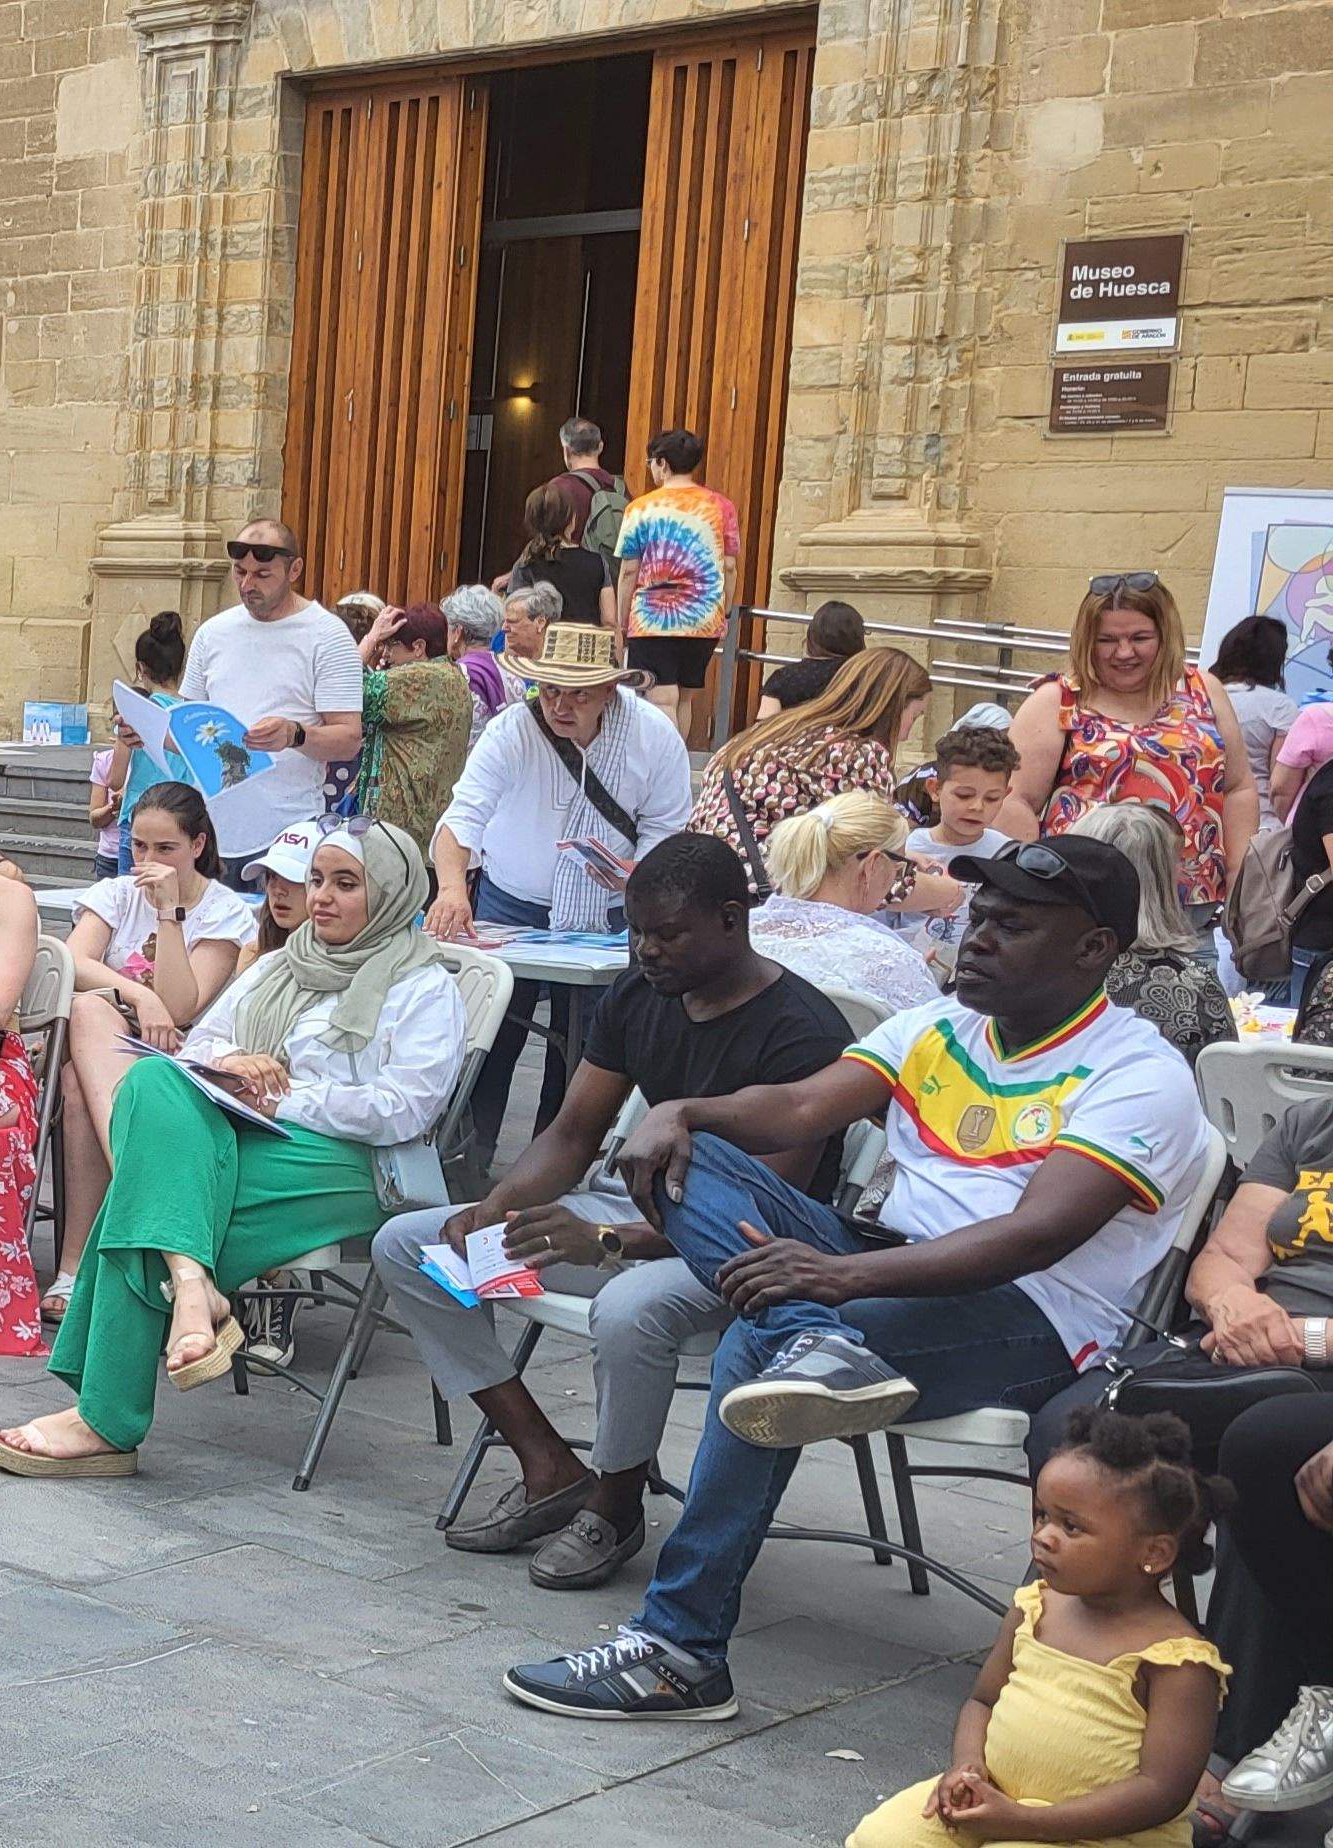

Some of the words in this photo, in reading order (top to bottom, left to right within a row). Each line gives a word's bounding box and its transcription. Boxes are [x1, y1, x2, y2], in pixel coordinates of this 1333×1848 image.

[1072, 265, 1135, 281] Museo
[1070, 283, 1093, 299] de
[1099, 281, 1171, 298] Huesca
[1062, 371, 1101, 382] Entrada
[1103, 370, 1142, 383] gratuita
